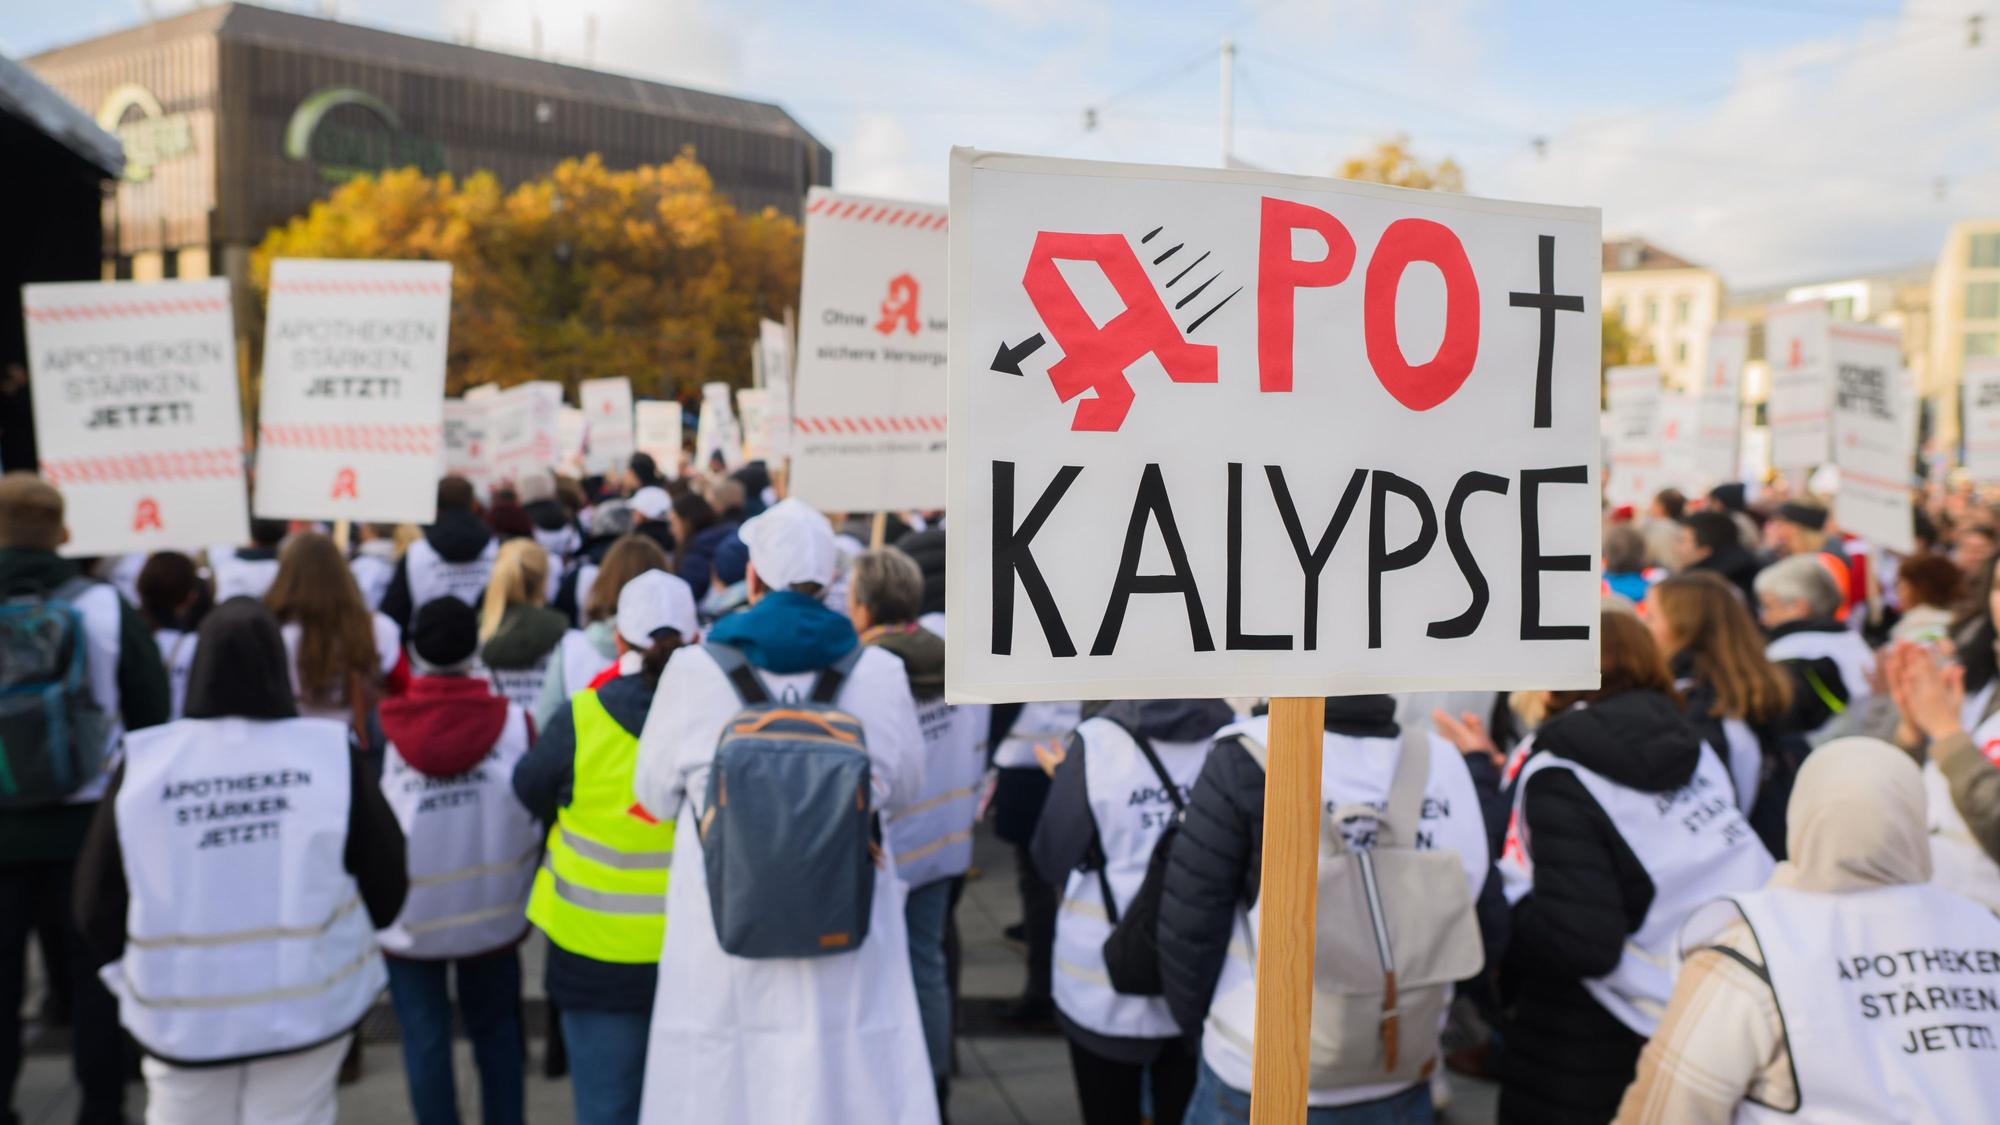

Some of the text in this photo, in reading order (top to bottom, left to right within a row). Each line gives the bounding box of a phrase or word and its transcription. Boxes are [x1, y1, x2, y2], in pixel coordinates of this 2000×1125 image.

[991, 460, 1592, 658] KALYPSE
[161, 768, 312, 801] APOTHEKEN
[196, 819, 280, 850] JETZT!
